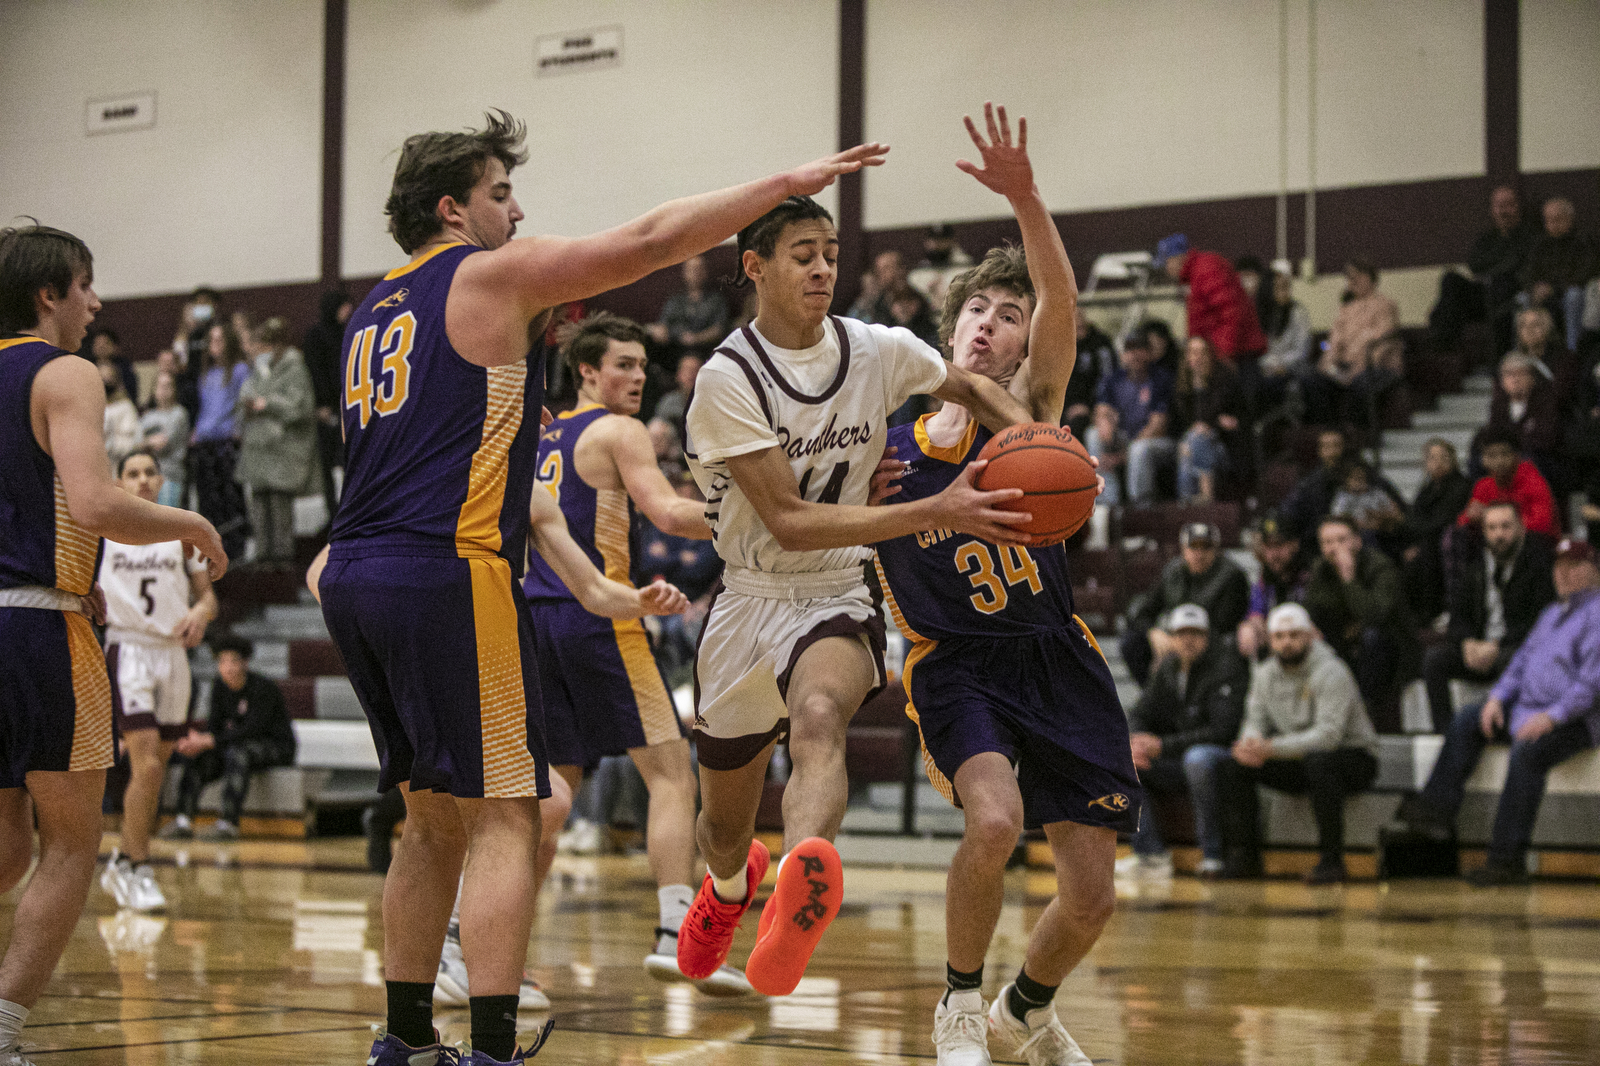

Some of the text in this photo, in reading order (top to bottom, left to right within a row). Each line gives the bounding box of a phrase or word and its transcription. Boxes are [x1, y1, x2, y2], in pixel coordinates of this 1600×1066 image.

[346, 310, 417, 429] 43
[778, 413, 871, 458] Panthers
[140, 577, 156, 616] 5
[954, 540, 1043, 615] 34
[793, 855, 828, 931] RARE
